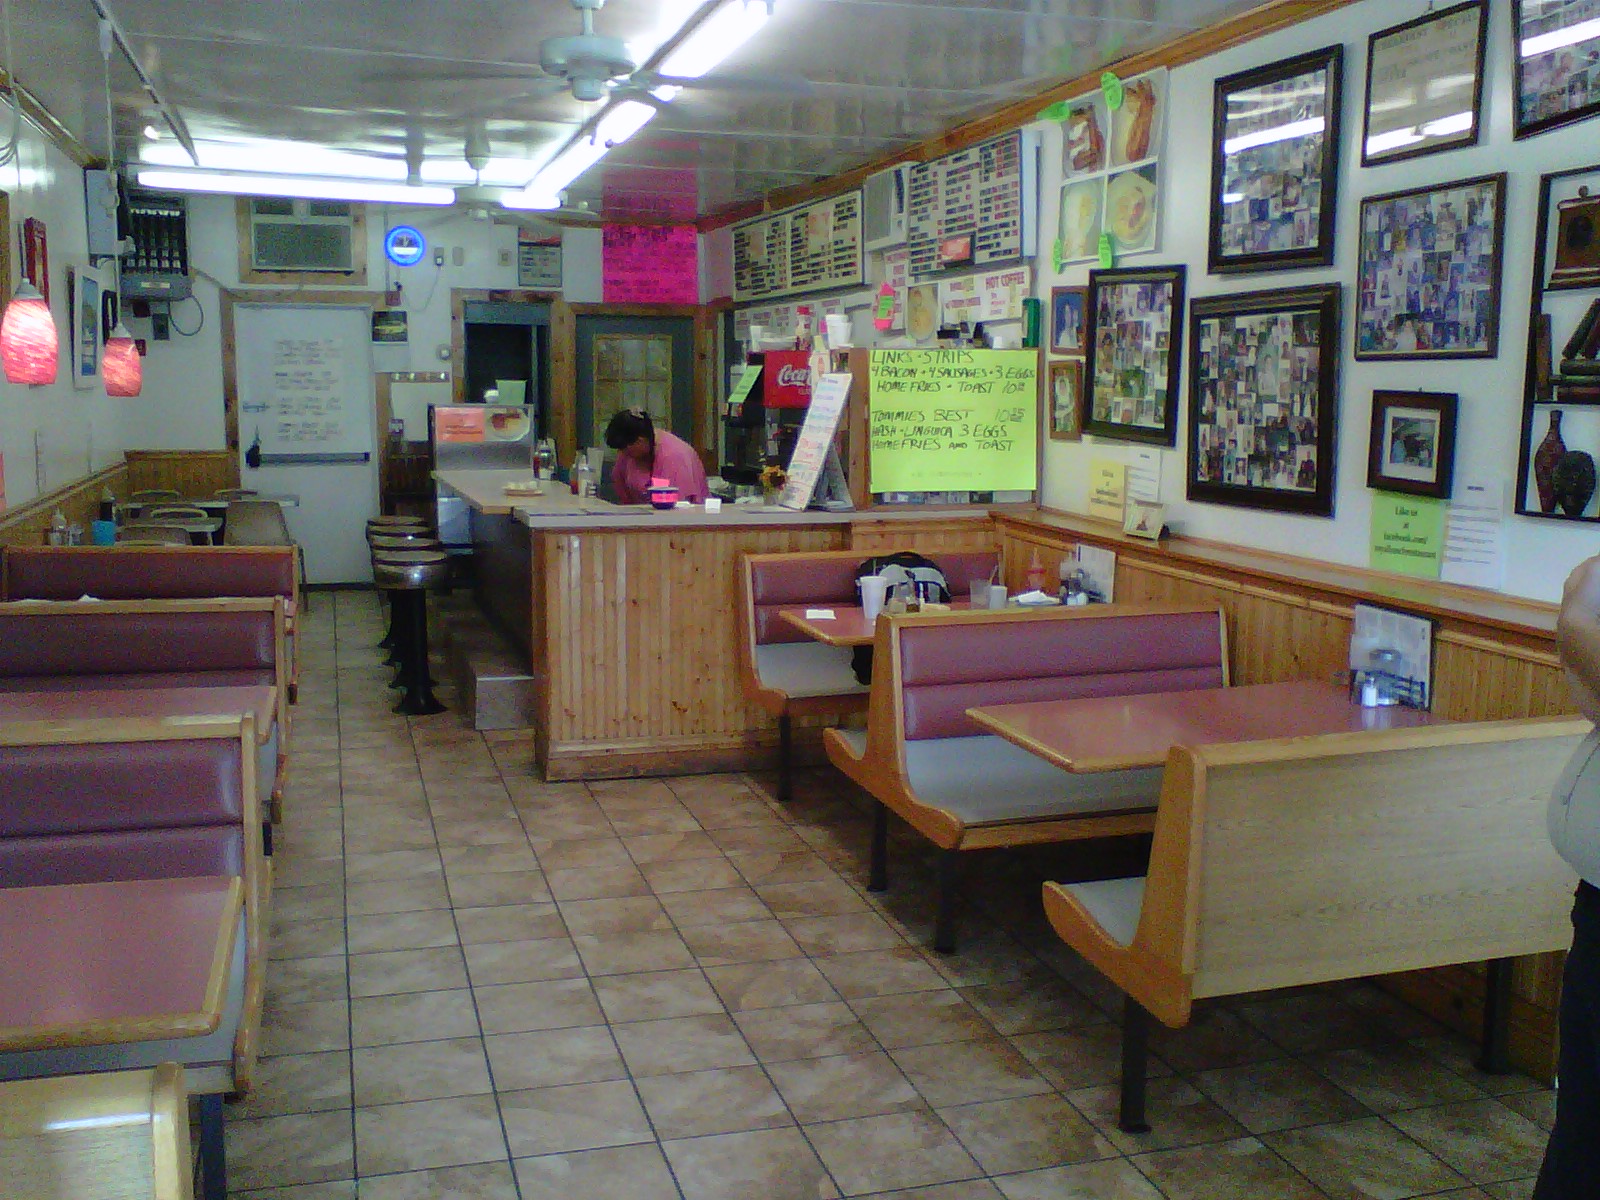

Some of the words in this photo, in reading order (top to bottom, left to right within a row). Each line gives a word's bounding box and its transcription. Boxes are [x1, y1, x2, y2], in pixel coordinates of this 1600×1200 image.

[872, 350, 913, 365] LINKS
[922, 350, 974, 365] STRIPS
[1005, 366, 1035, 380] EGGS
[958, 380, 996, 394] TOAST
[934, 408, 975, 422] BEST
[959, 423, 970, 438] 3
[972, 423, 1008, 438] EGGS
[975, 439, 1014, 452] TOAST
